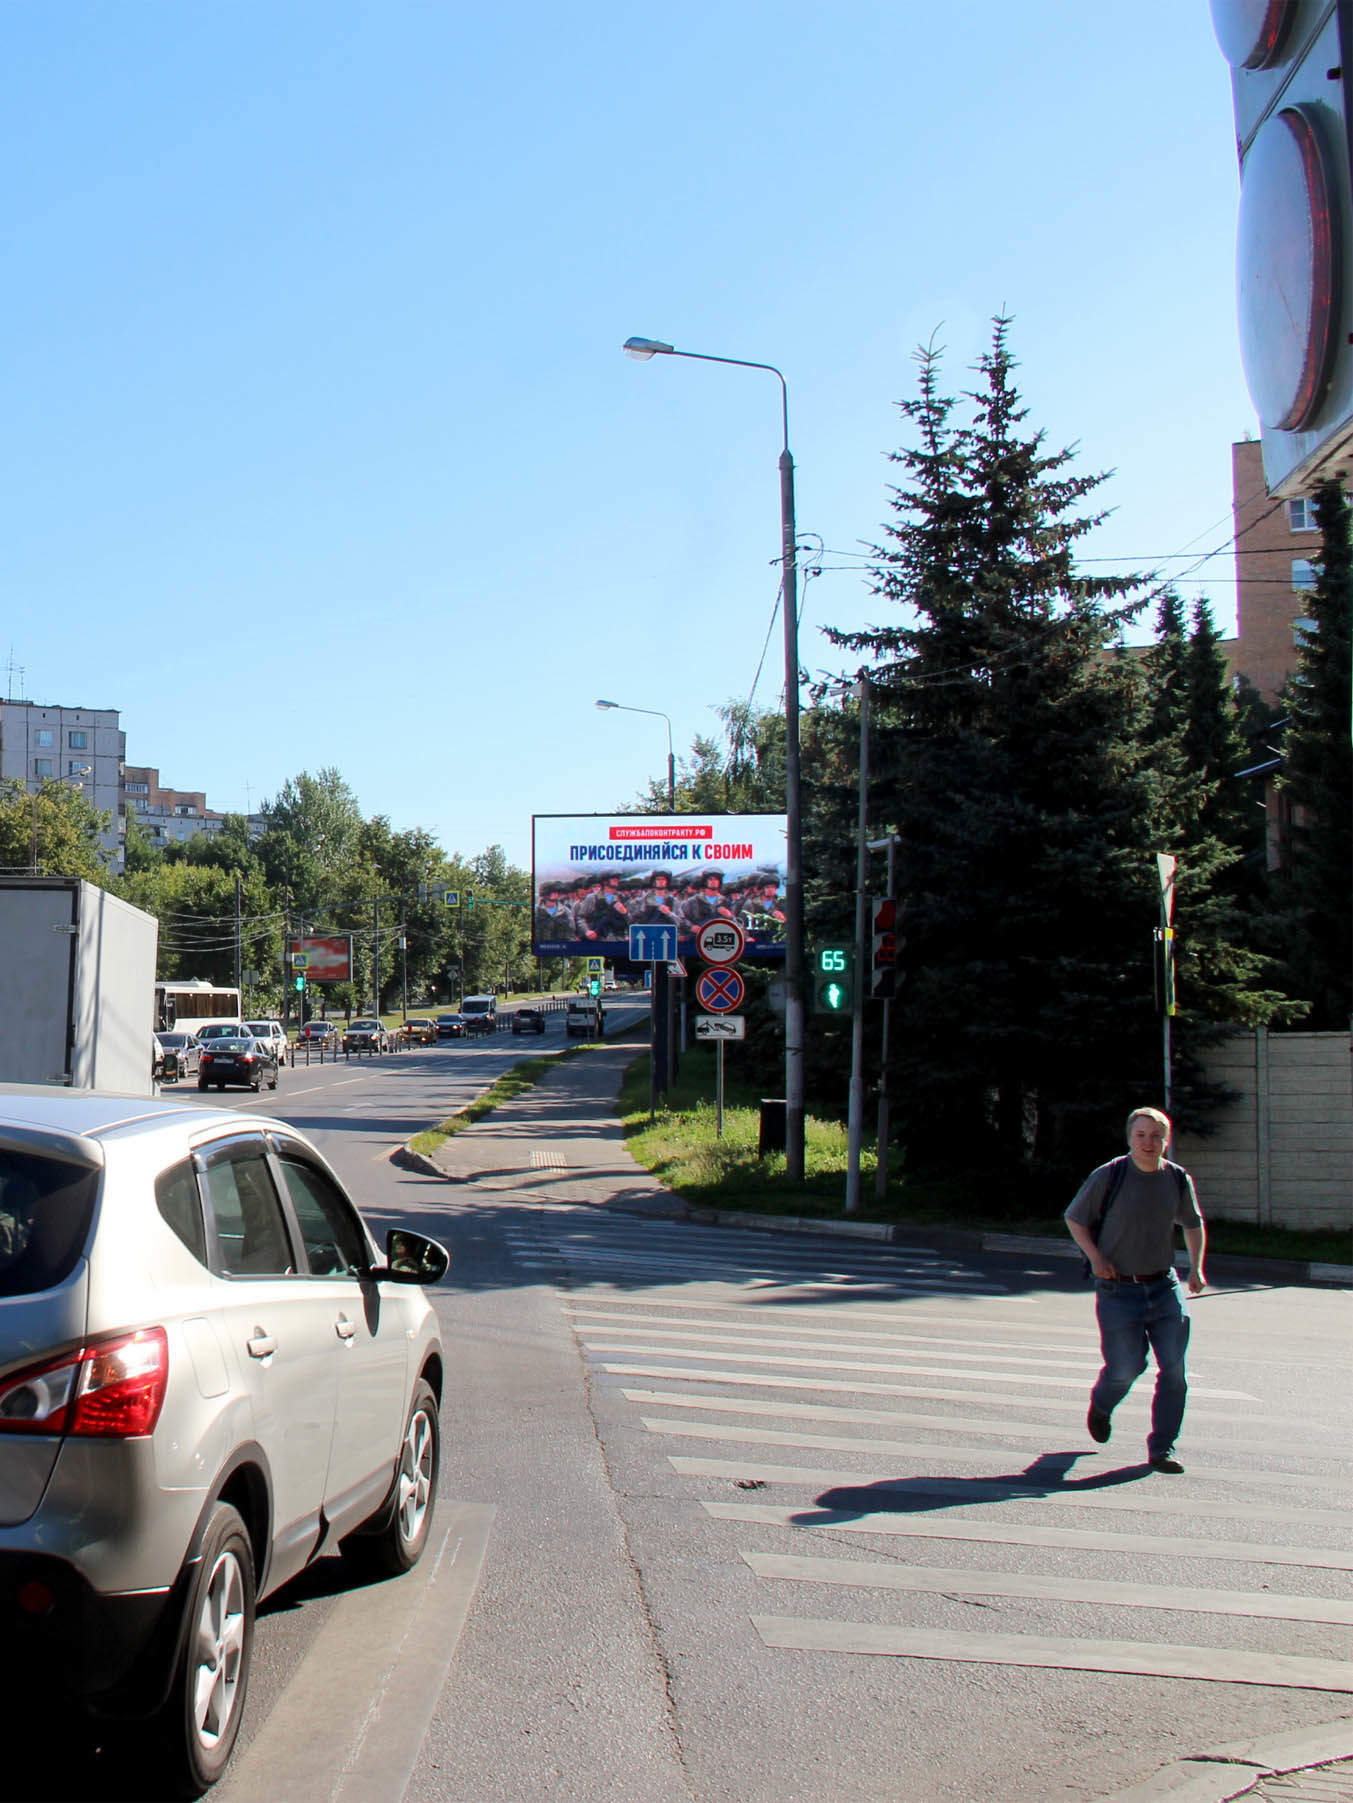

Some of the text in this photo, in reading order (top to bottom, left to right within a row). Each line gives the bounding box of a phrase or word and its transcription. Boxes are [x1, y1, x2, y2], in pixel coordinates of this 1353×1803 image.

[615, 828, 707, 838] СЛУЖБАПОКОНТРАКТУ.РФ
[570, 841, 753, 861] ПРИСОЕДИНЯЙСЯ К СВОИМ
[821, 950, 845, 971] 65
